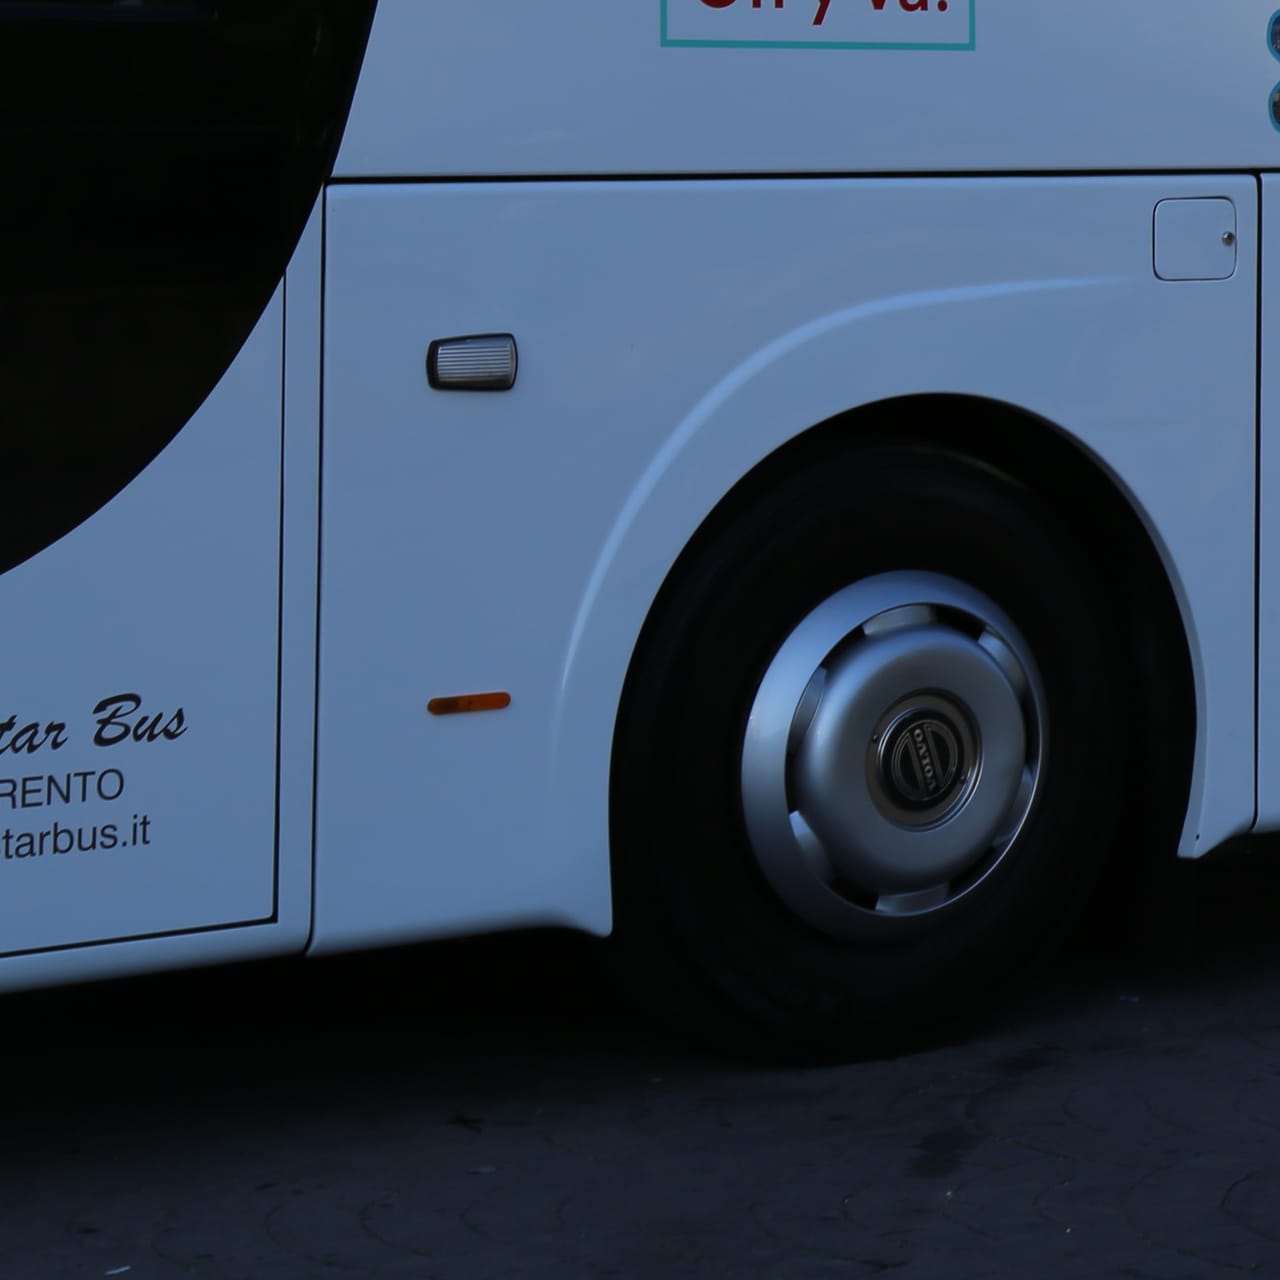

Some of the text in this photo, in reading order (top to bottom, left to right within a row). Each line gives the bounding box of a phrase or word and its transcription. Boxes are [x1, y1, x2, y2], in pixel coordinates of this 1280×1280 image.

[92, 693, 188, 747] Bus
[913, 728, 937, 793] VOLVO
[2, 814, 151, 860] tarbus.it
